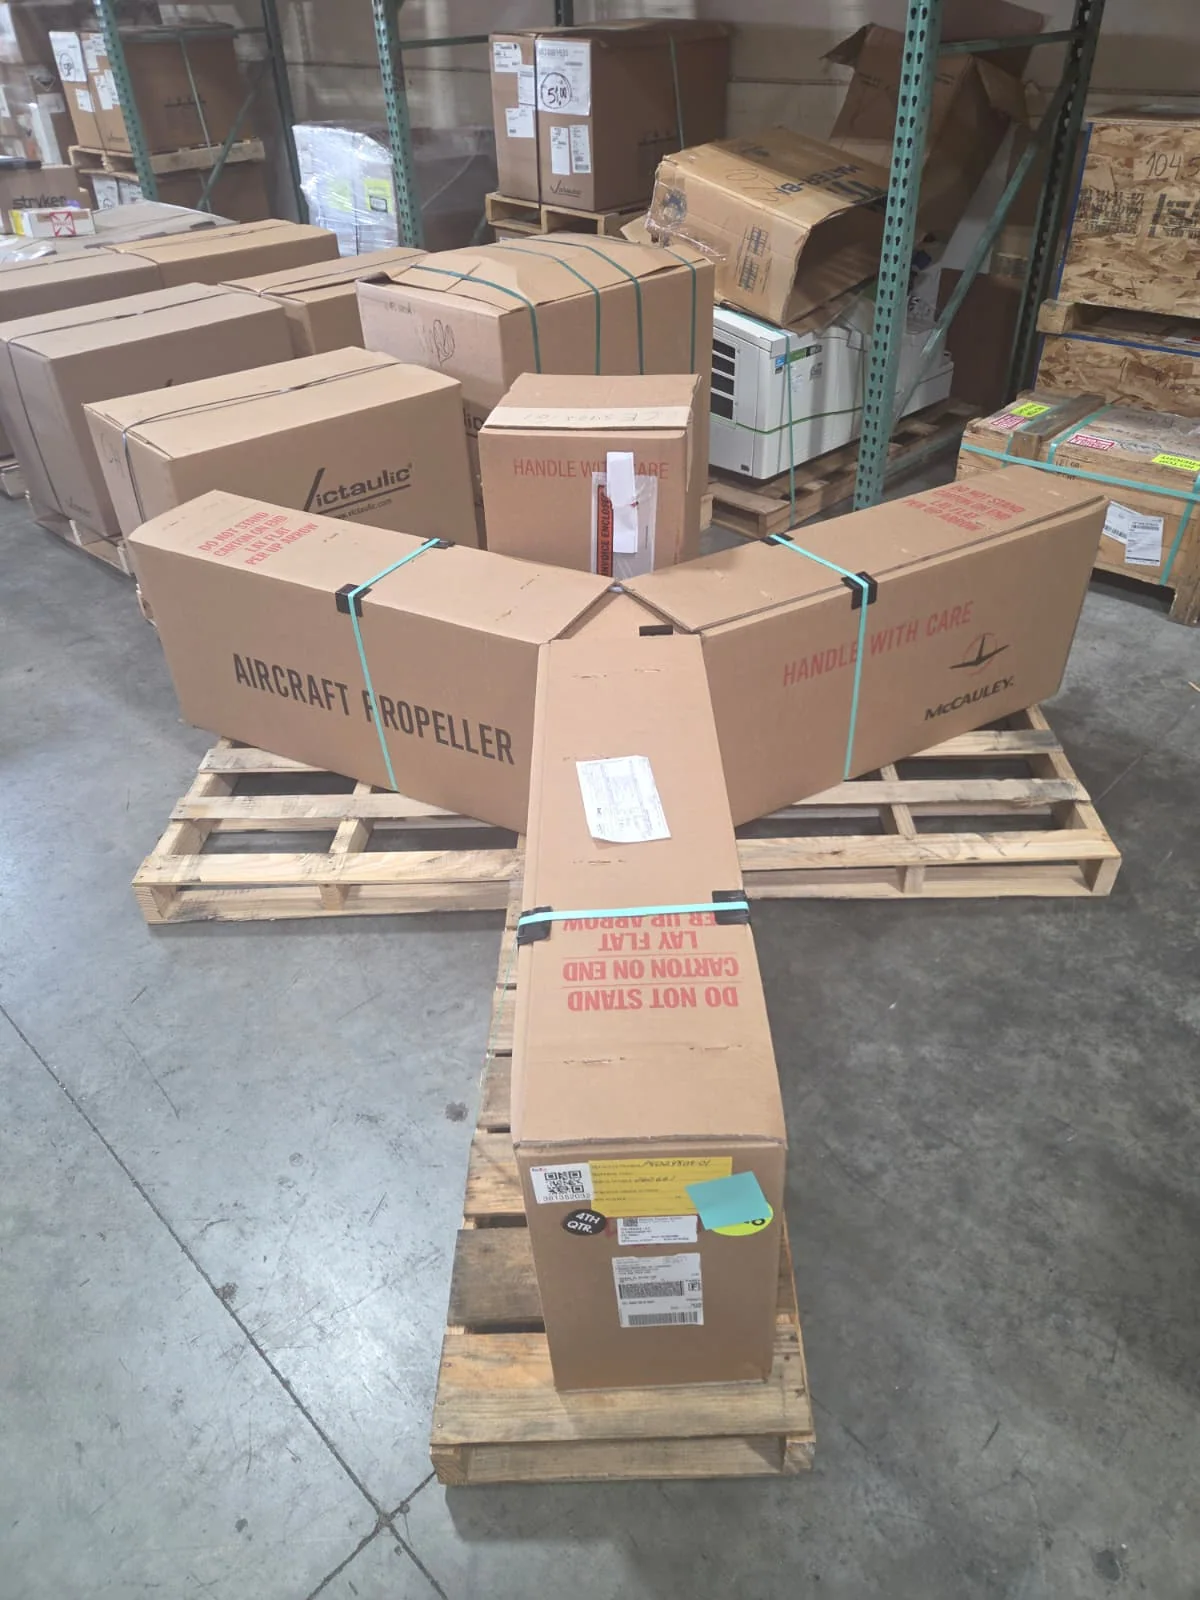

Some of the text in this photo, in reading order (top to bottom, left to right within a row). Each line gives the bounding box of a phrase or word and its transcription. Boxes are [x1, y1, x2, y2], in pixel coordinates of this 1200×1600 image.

[513, 458, 669, 479] HANDLE WI ARE
[600, 492, 611, 538] ENCLOSE
[198, 511, 269, 551] DO NOT STAND
[213, 515, 288, 556] CARTON ON END
[245, 527, 291, 552] LAY FLAT
[245, 522, 318, 565] PER UP ARROW
[783, 601, 974, 687] HANDLE WITH CARE
[233, 653, 515, 765] AIRCRAFT PROPELLER
[563, 912, 716, 931] ER UP ARROW
[598, 931, 698, 951] LAY FLAT
[563, 957, 739, 981] CARTON ON END
[568, 987, 738, 1011] DO NOT STAND
[567, 1220, 593, 1233] QTR.
[576, 1212, 600, 1224] 4TH
